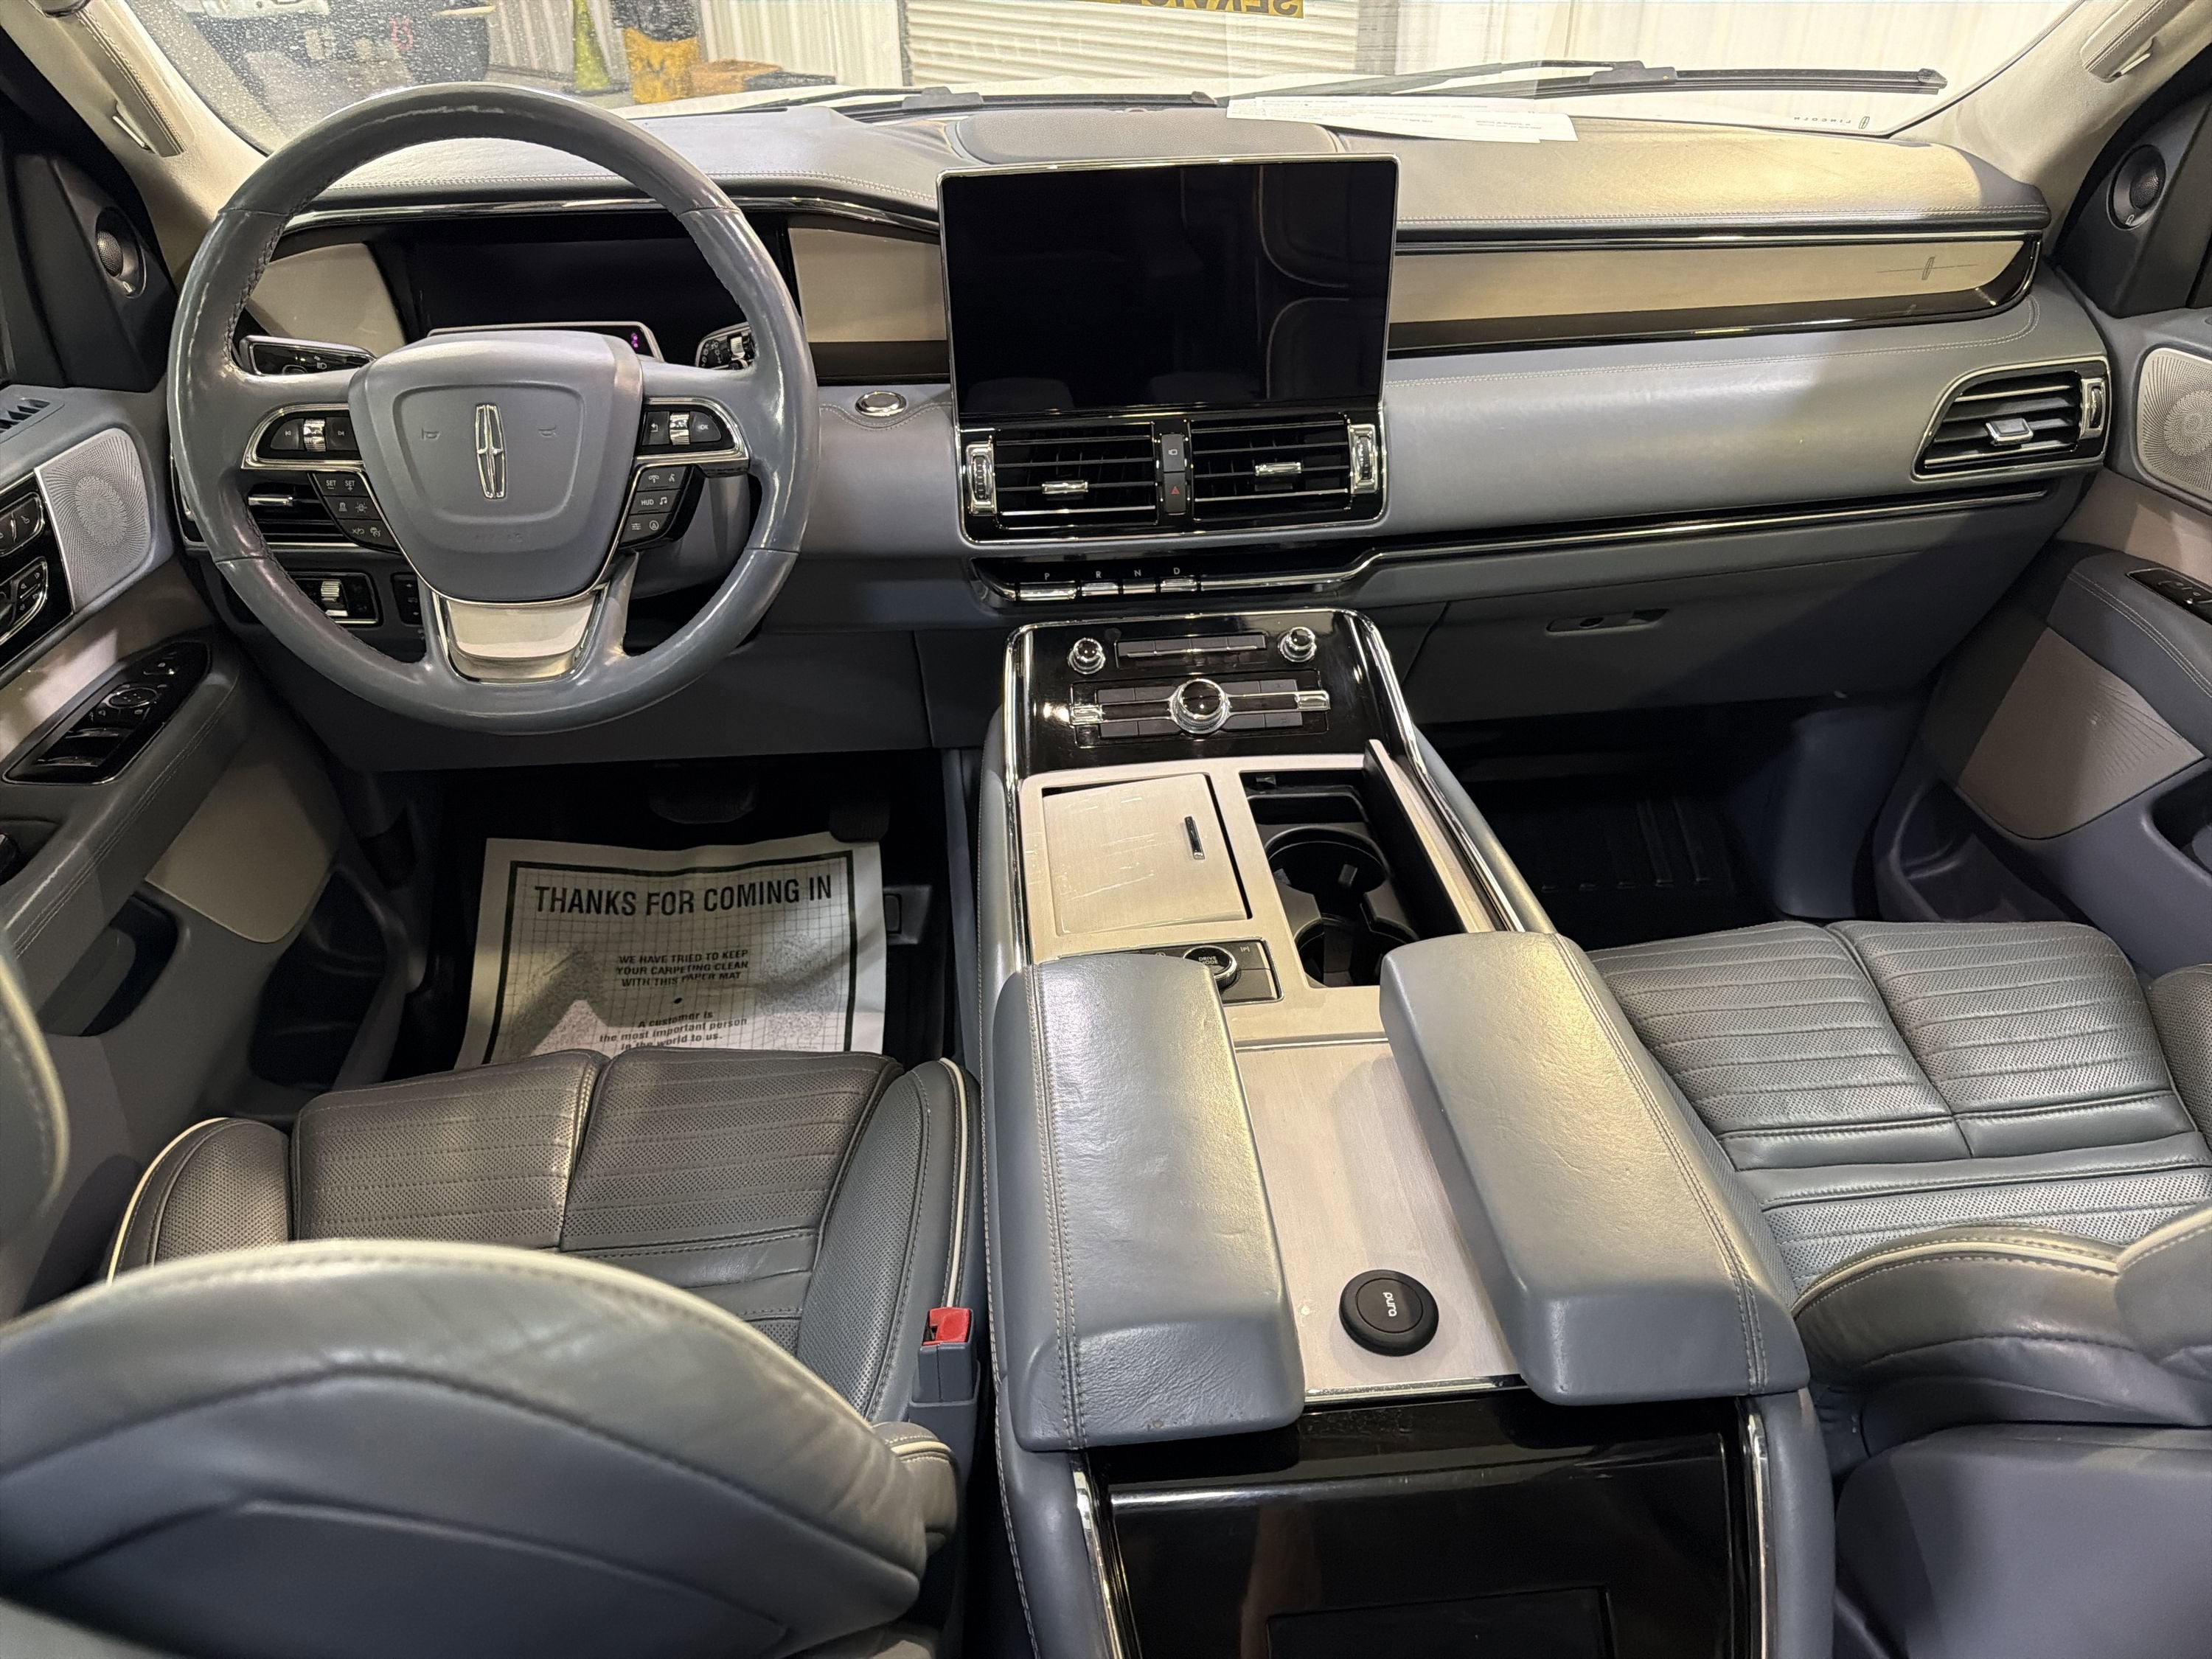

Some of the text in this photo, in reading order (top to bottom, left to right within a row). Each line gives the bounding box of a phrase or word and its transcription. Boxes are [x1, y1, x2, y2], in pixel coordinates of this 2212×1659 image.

[535, 874, 832, 916] THANKS FOR COMING IN
[619, 949, 748, 964] WE HAVE TRIED TO KEEP
[616, 961, 748, 975] YOUR CARPETING CLEAN
[622, 978, 650, 987] WITH
[654, 977, 678, 986] THIS
[681, 974, 715, 983] PAPER
[649, 1012, 700, 1027] customer
[599, 1018, 748, 1042] the most important person
[657, 1034, 687, 1046] world
[691, 1034, 702, 1042] to
[1382, 1292, 1397, 1317] pura
